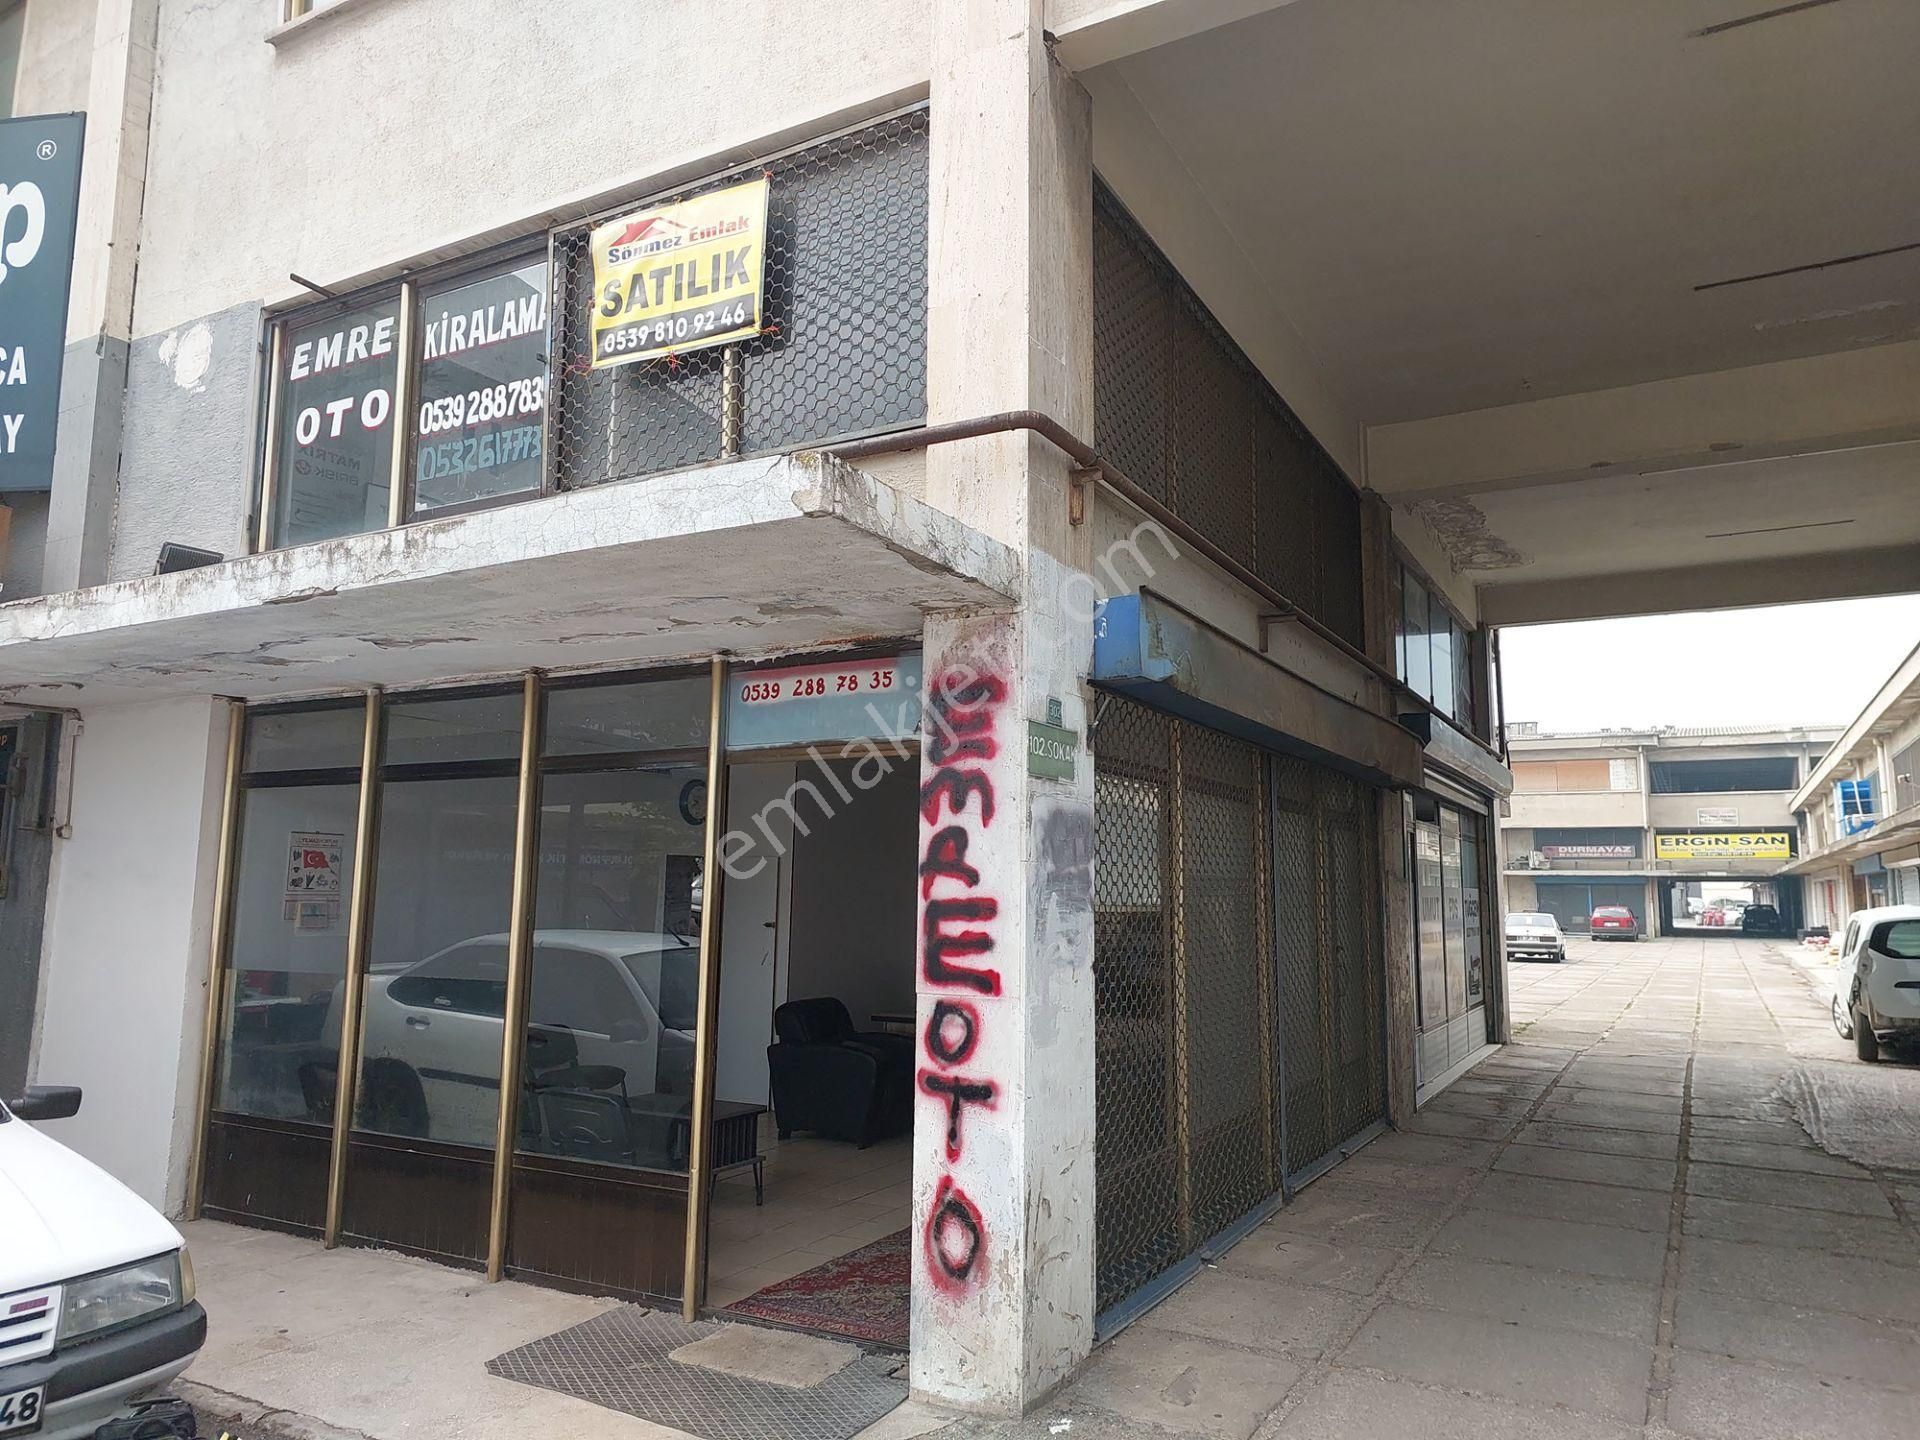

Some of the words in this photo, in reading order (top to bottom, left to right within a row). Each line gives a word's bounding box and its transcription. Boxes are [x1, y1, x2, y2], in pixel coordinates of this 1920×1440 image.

[608, 235, 682, 264] Sönmez
[688, 215, 751, 242] Emlak
[600, 244, 752, 318] SATILIK
[290, 316, 395, 381] EMRE
[604, 326, 649, 353] 0539
[654, 317, 687, 342] 810
[693, 310, 715, 333] 92
[720, 303, 745, 326] 46
[0, 414, 25, 453] Y
[296, 388, 390, 446] OTO
[741, 682, 781, 702] 0539
[792, 677, 825, 697] 288
[836, 675, 858, 692] 78
[869, 670, 893, 689] 35
[1558, 845, 1632, 853] DURMAYAZ
[918, 1000, 1000, 1296] OTO
